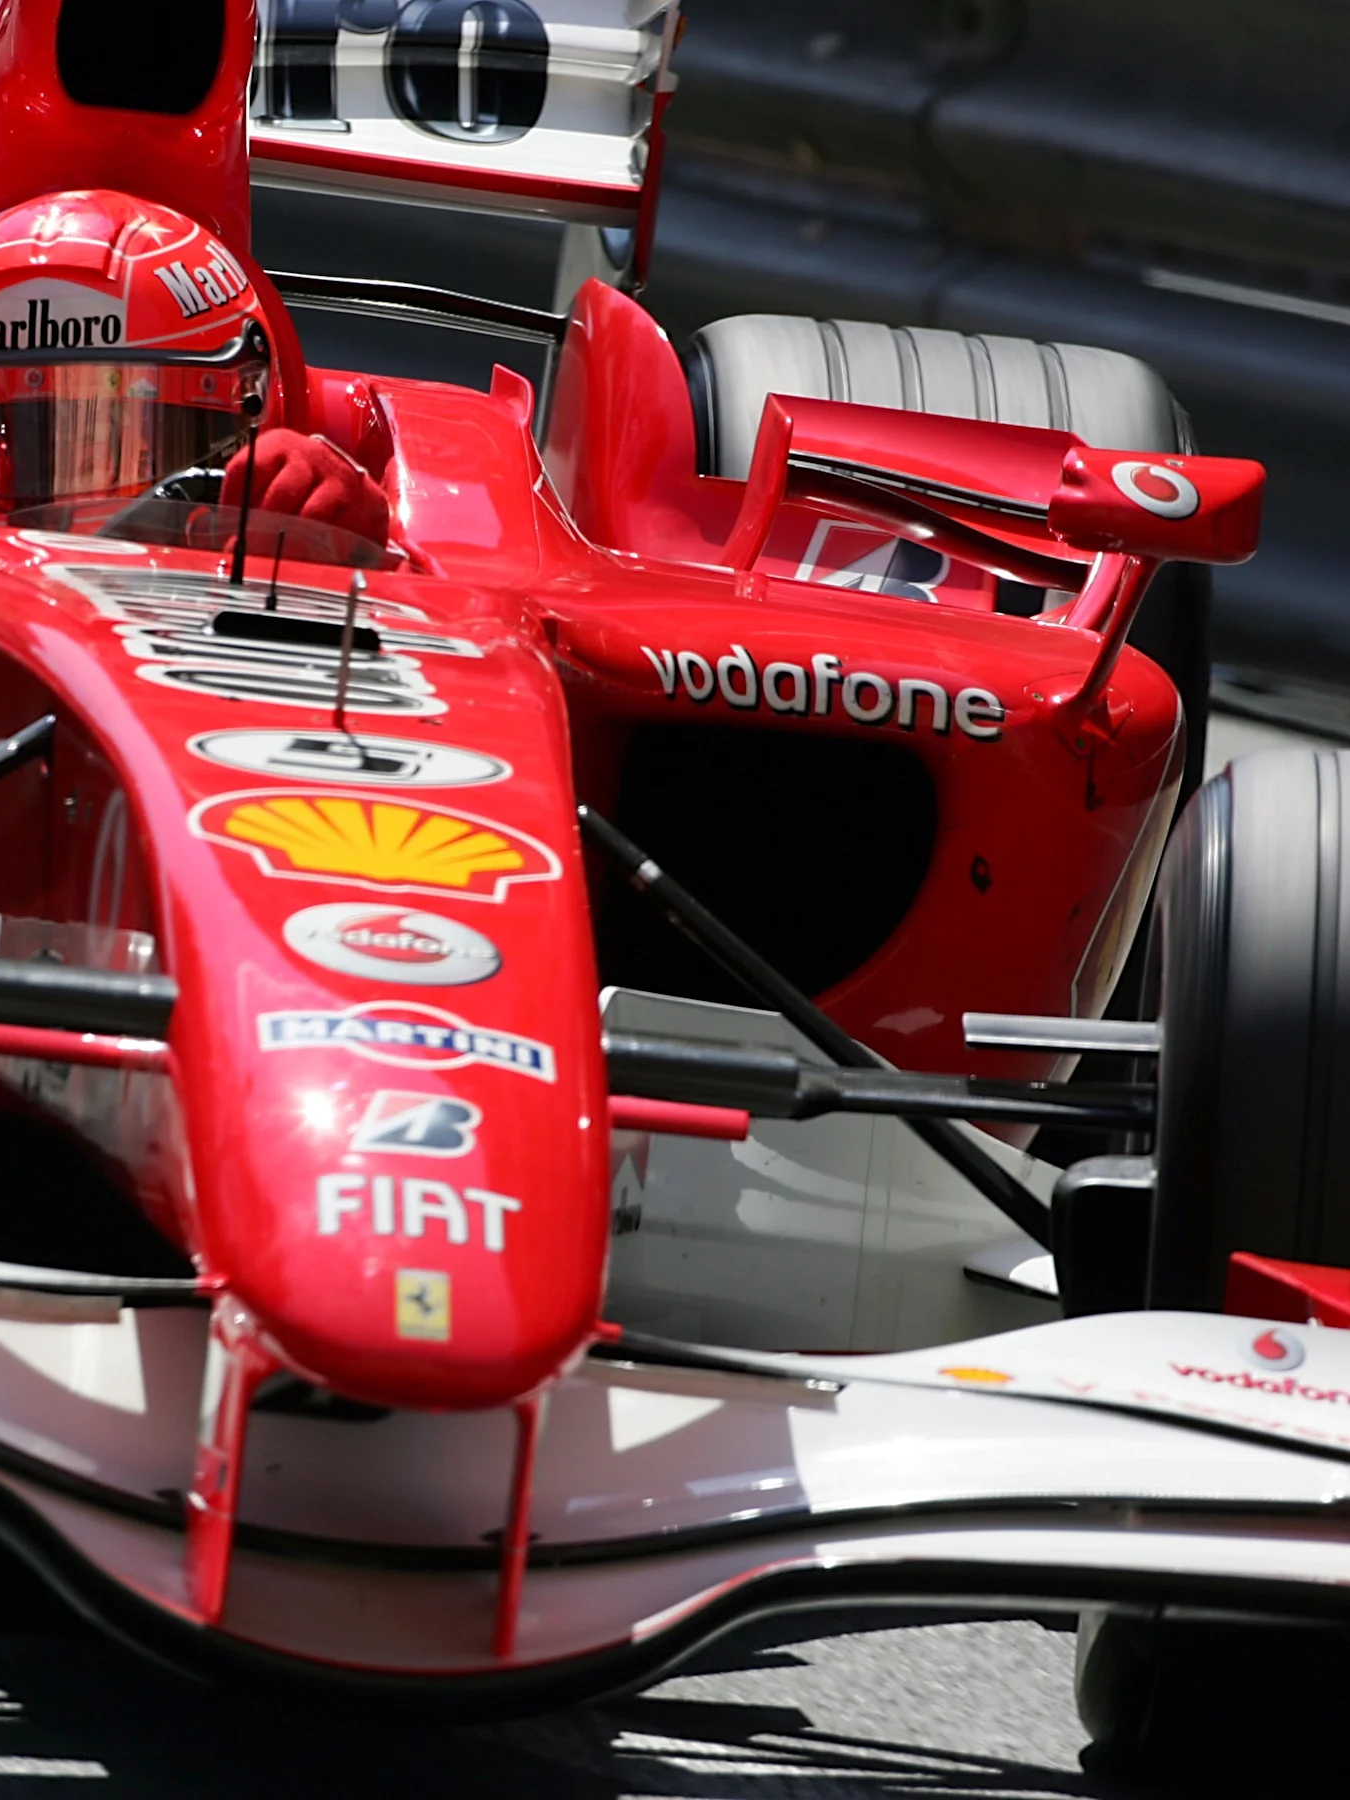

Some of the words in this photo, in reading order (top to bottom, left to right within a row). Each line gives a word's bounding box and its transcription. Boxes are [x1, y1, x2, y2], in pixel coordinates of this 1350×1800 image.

[640, 643, 1006, 739] vodafone
[281, 1018, 537, 1068] MARTINI
[316, 1172, 523, 1253] FIAT
[1168, 1360, 1350, 1408] vodafon
